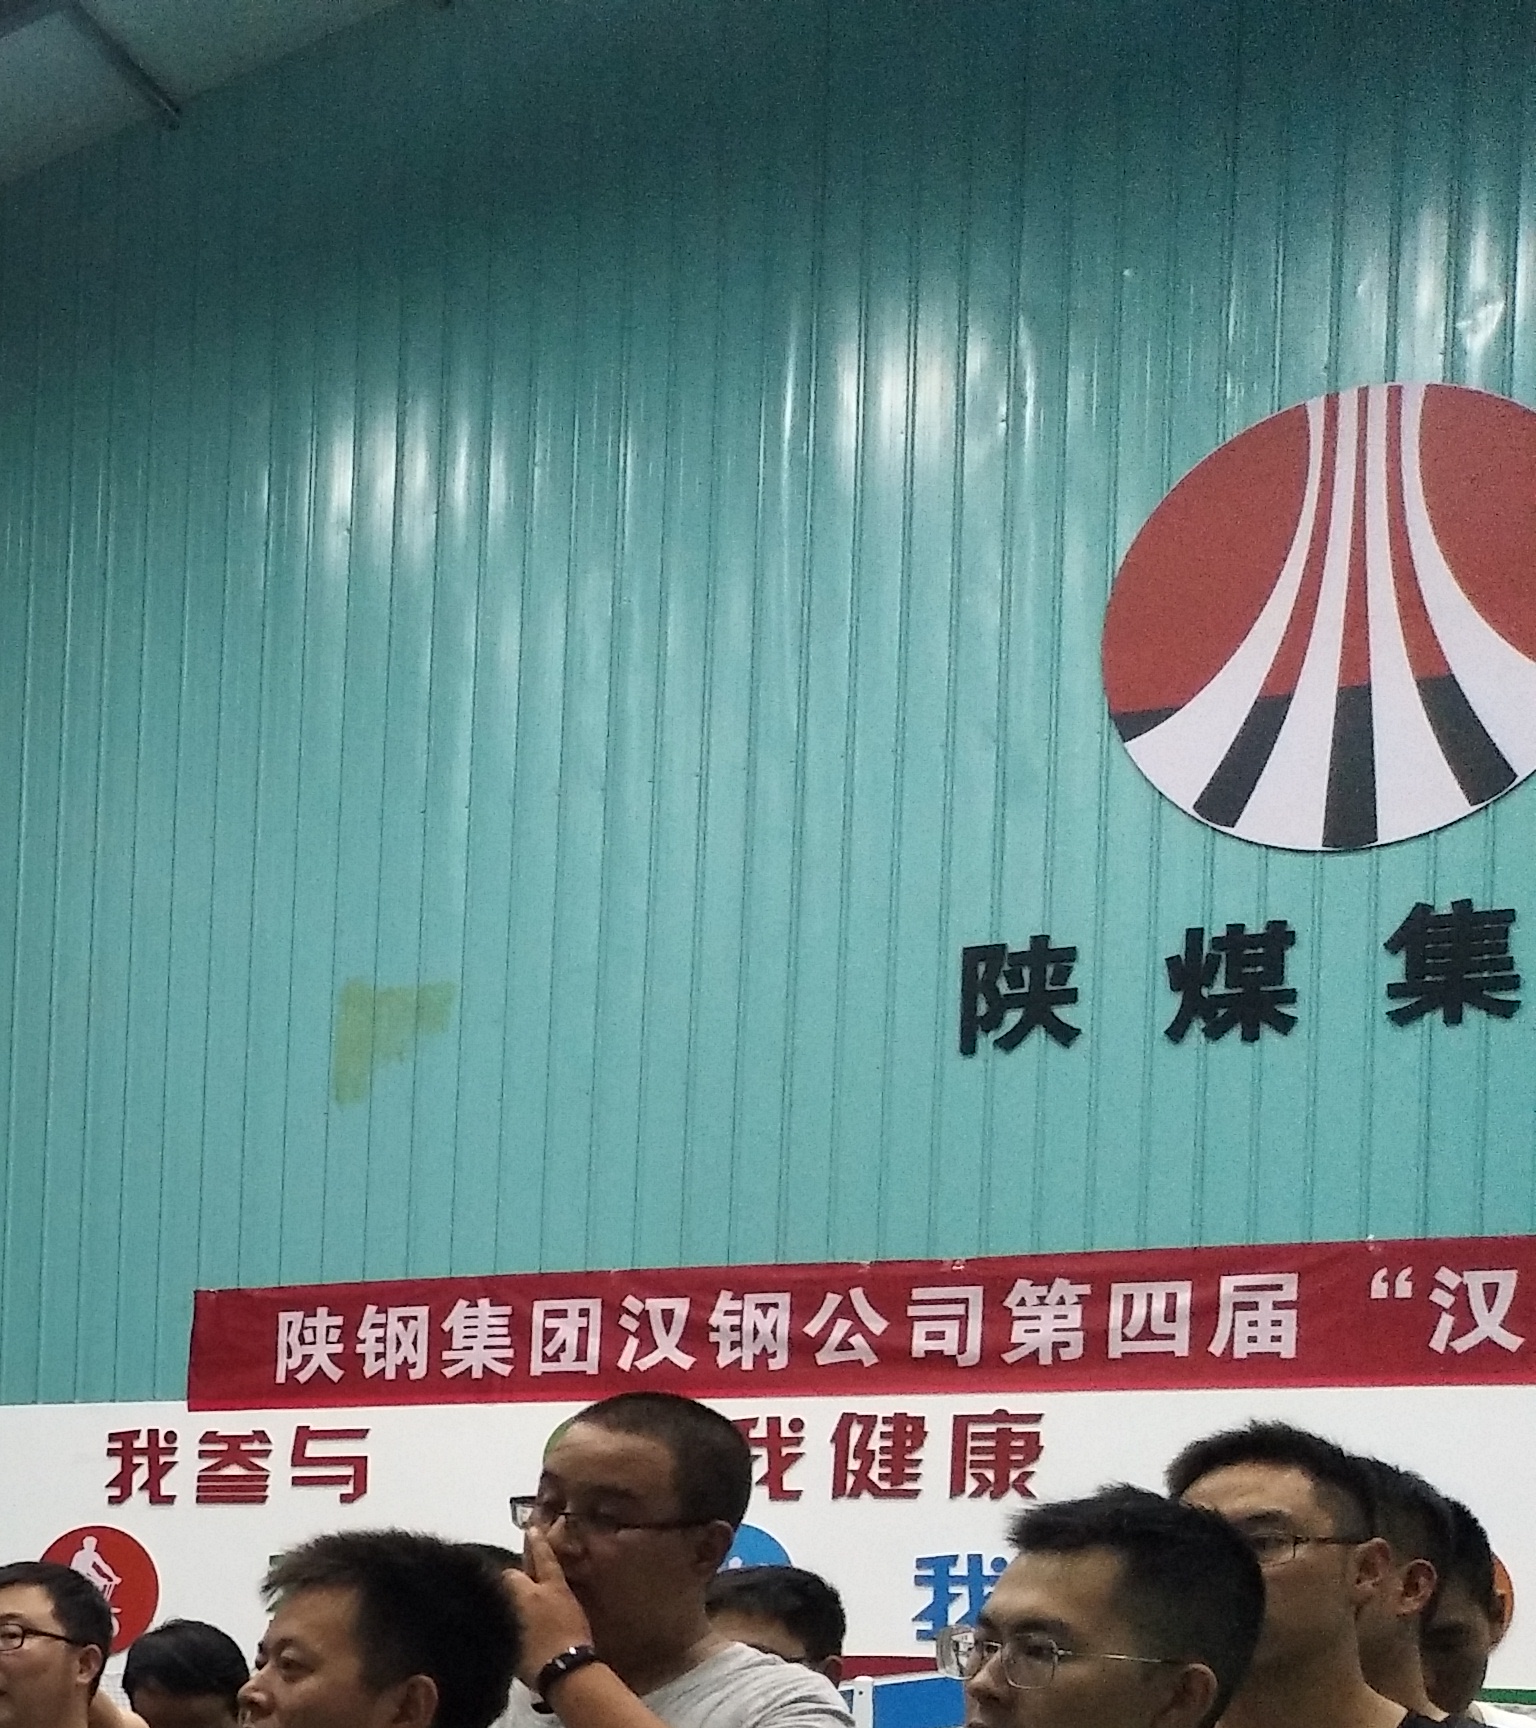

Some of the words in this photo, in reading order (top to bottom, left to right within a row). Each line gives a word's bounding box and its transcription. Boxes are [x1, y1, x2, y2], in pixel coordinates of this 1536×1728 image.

[958, 898, 1522, 1056] 陕煤集
[105, 1425, 371, 1505] 我参与
